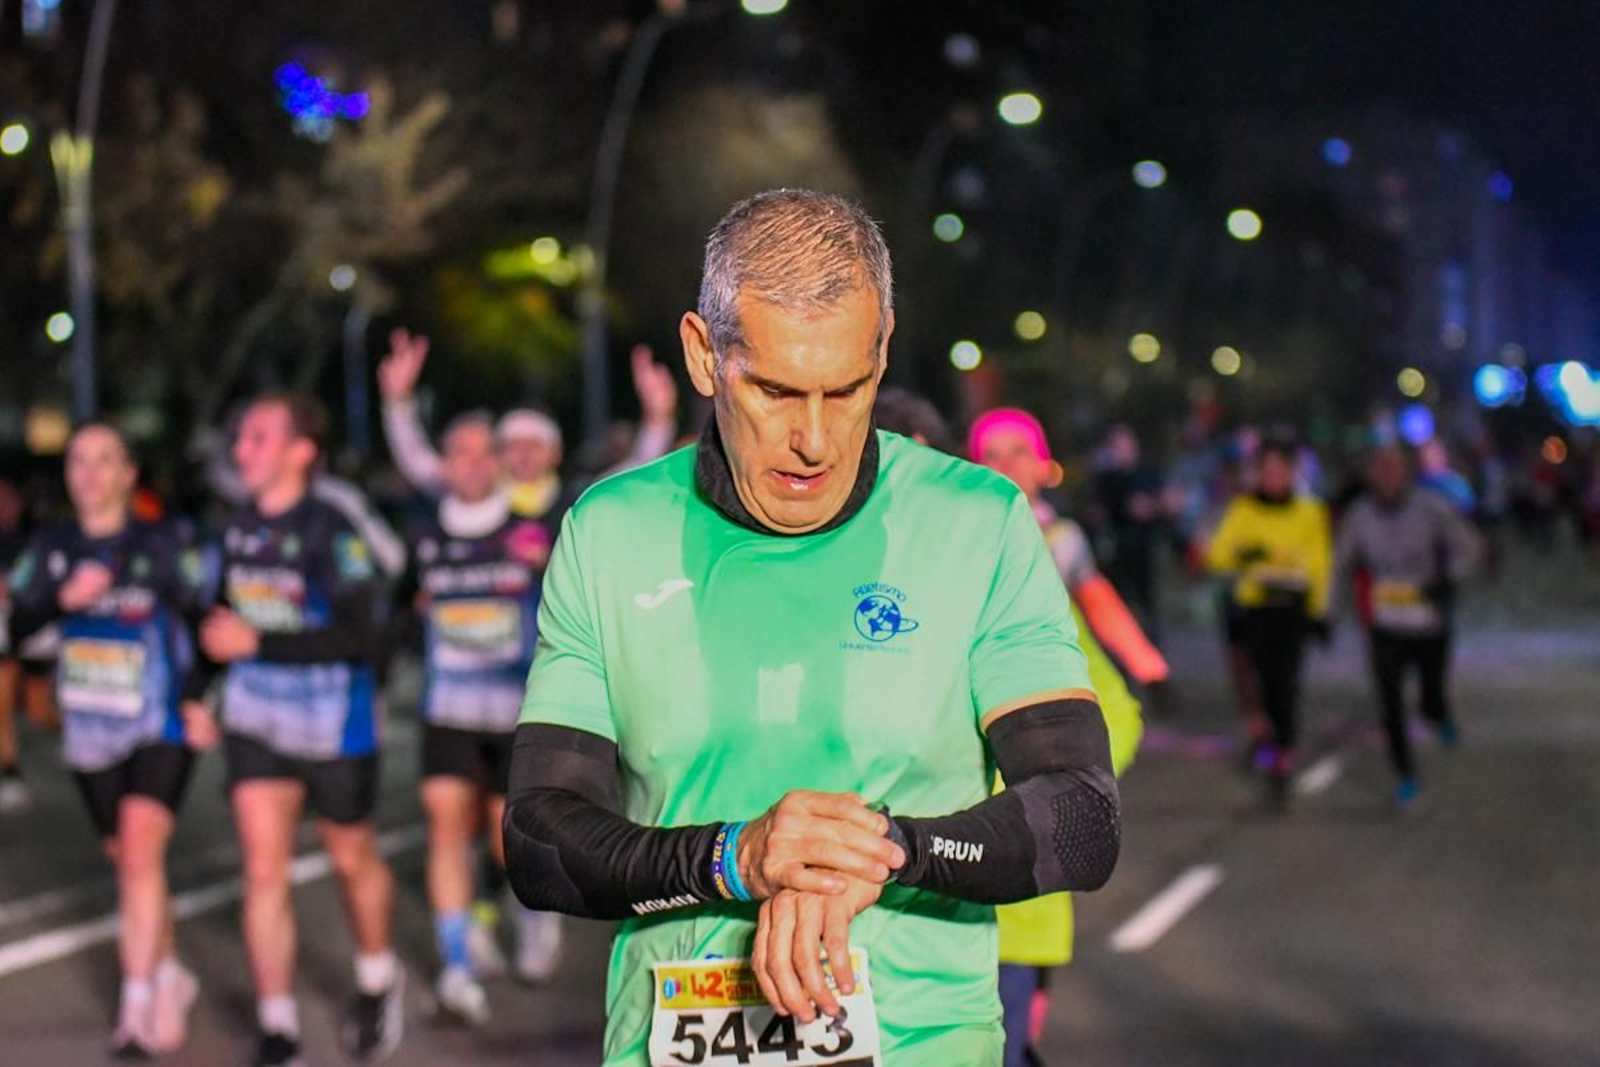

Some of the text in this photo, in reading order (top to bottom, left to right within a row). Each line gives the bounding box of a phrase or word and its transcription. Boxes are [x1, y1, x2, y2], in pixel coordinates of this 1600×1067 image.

[929, 834, 984, 863] PRUN
[691, 970, 724, 998] 42
[669, 1005, 854, 1065] 5443
